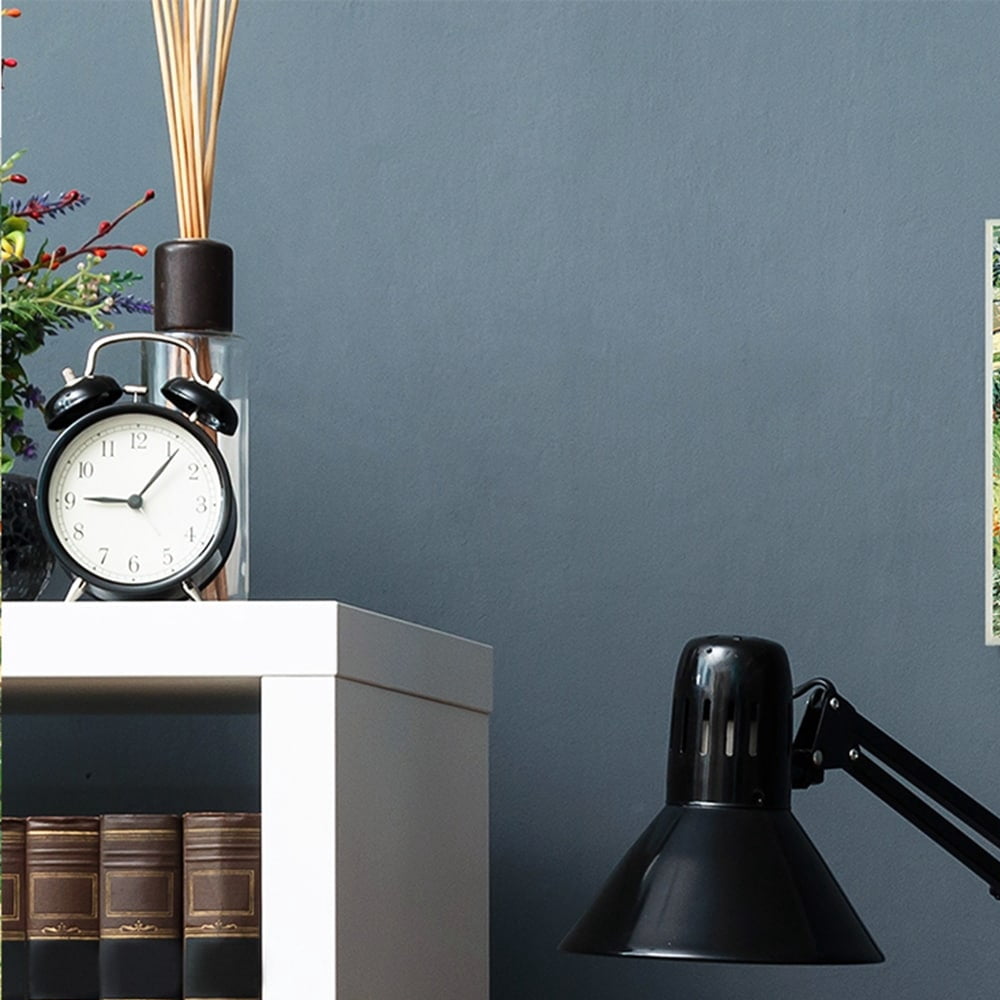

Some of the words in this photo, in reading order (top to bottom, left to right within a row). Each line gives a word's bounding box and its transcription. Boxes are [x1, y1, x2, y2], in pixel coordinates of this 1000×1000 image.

[101, 440, 115, 458] 11
[130, 432, 148, 450] 12
[166, 440, 172, 457] 1
[77, 461, 94, 479] 10
[188, 464, 199, 481] 2
[64, 492, 76, 510] 9
[196, 496, 207, 513] 3
[73, 523, 85, 540] 8
[184, 526, 197, 543] 4
[98, 547, 110, 565] 7
[128, 555, 140, 573] 6
[163, 548, 173, 565] 5
